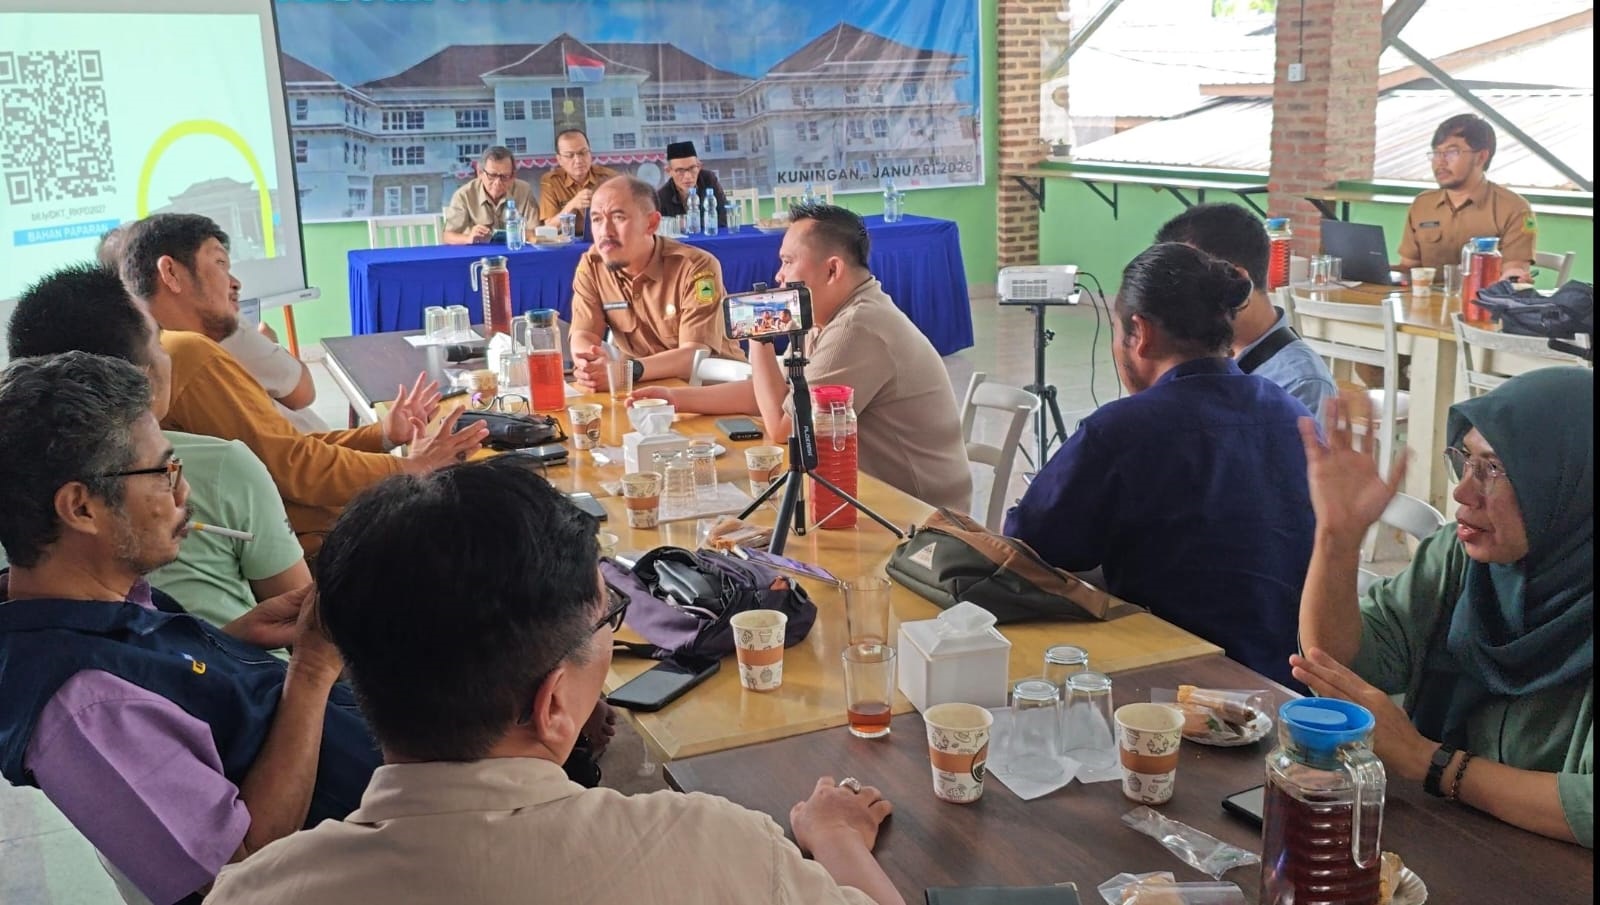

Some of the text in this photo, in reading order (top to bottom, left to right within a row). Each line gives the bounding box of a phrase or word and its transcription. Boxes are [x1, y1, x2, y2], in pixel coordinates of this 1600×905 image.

[777, 160, 974, 184] KUNINGAN, JANUARI 2026
[27, 223, 108, 243] BAHAN PAPARAN
